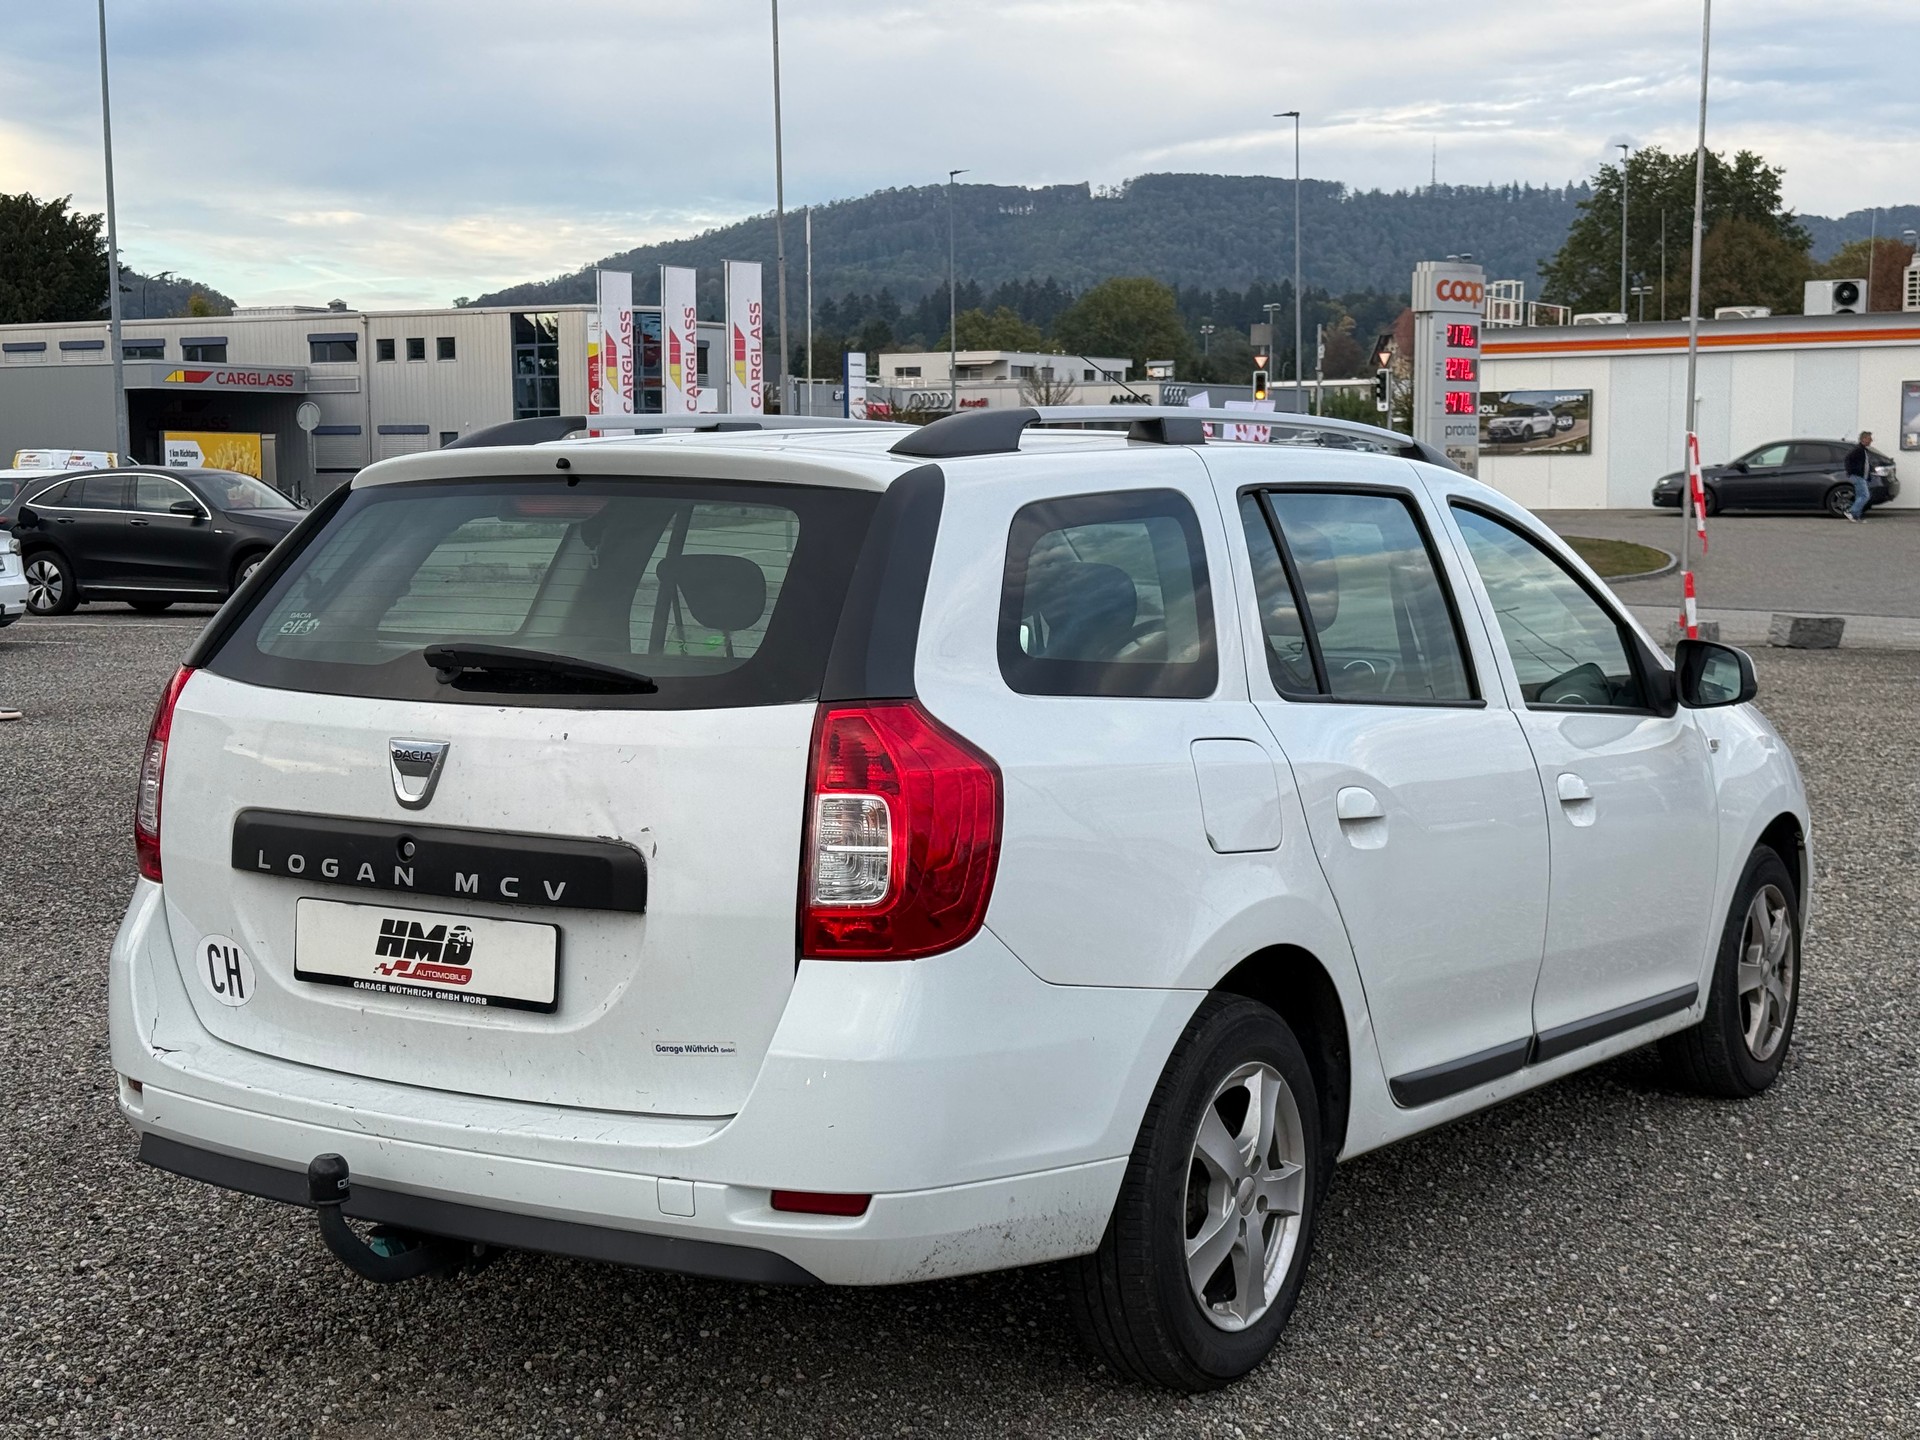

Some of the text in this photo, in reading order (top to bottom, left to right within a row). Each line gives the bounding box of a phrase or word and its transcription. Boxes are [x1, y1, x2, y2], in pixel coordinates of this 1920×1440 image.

[1436, 279, 1484, 309] coop
[620, 310, 633, 414] CARGLASS
[684, 307, 697, 412] CARGLASS
[749, 302, 762, 409] CARGLASS
[215, 371, 294, 387] CARGLASS
[959, 398, 989, 408] Audi
[1109, 393, 1153, 405] AMAG
[1445, 423, 1477, 439] pronto
[394, 749, 434, 762] DACIA
[258, 849, 414, 887] LOGAN
[207, 943, 245, 999] CH
[416, 969, 468, 982] AUTOMOBILE
[353, 981, 488, 1006] GARAGE WÜTHRICH GMBH WORB
[655, 1044, 684, 1055] Garage
[684, 1044, 719, 1053] Wüthrich
